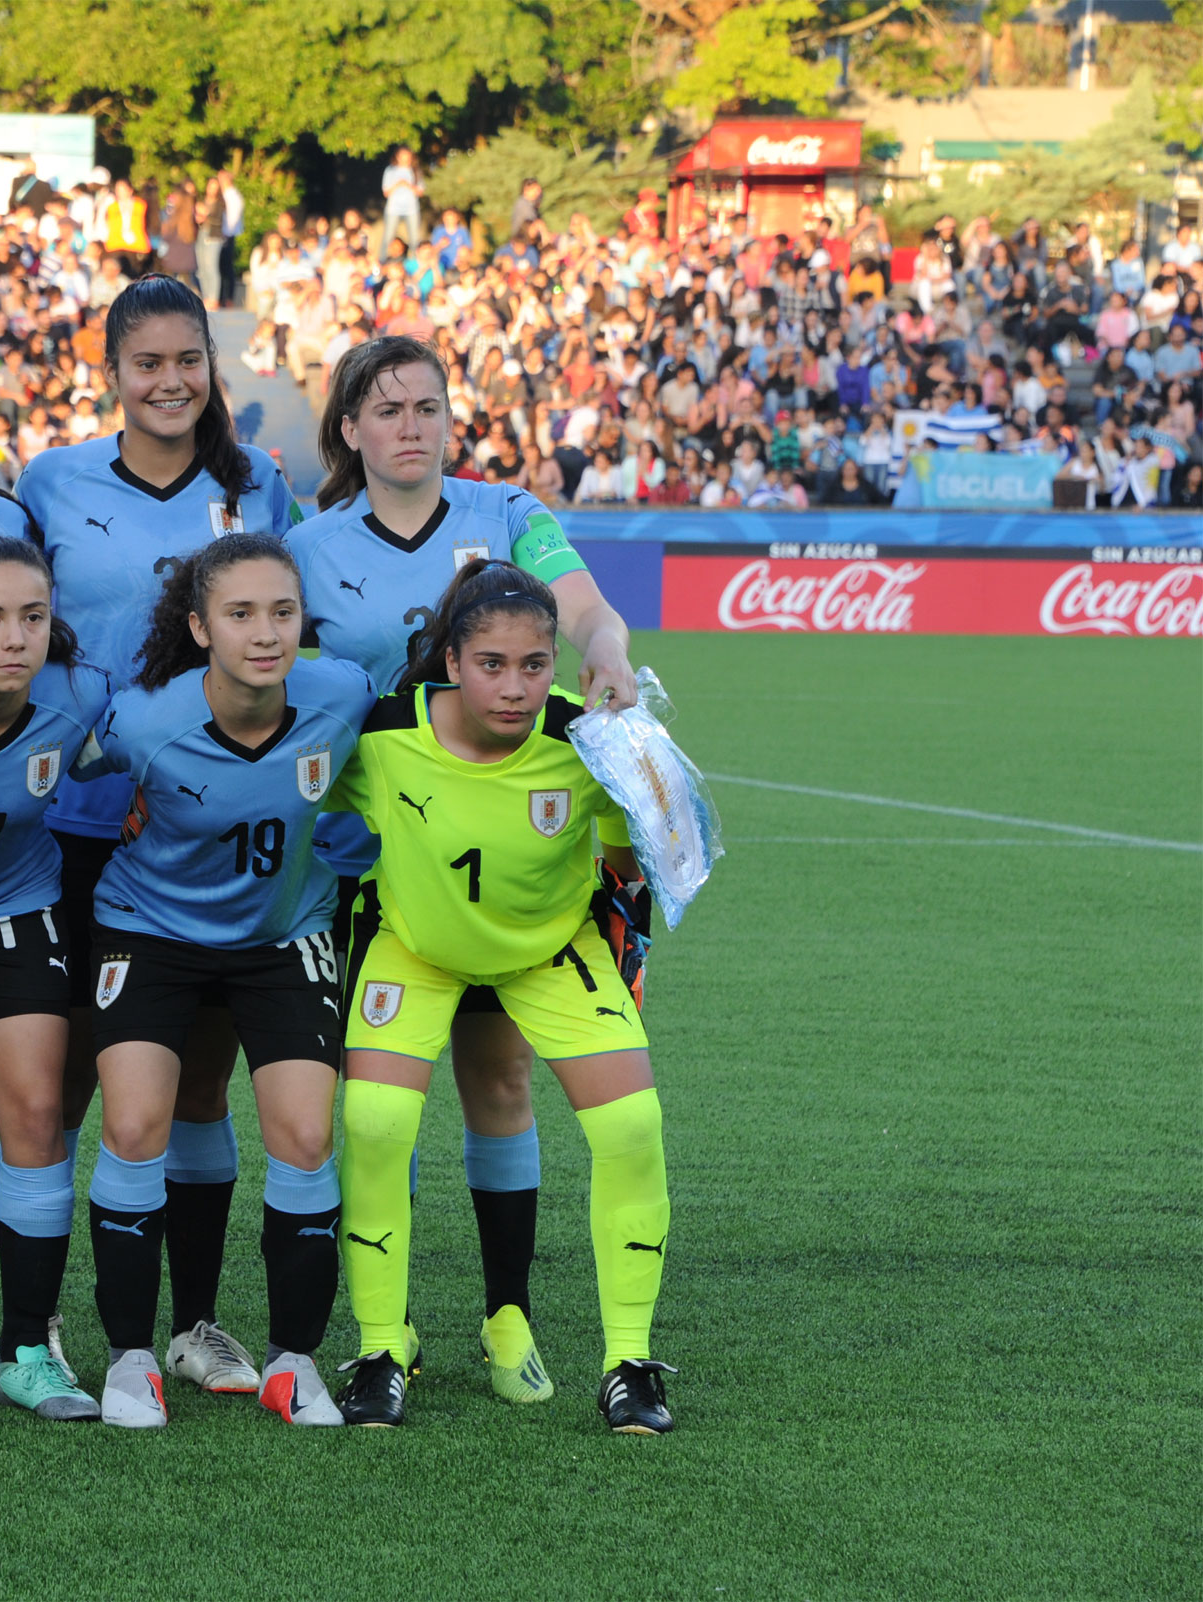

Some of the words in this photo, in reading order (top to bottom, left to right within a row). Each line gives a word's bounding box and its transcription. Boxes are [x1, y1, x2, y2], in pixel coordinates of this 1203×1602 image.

[937, 474, 1053, 500] ESCUELA
[769, 542, 801, 559] SIN
[1091, 546, 1124, 563] SIN
[718, 560, 928, 631] Coca-Cola
[218, 817, 285, 878] 19
[450, 848, 481, 903] 1
